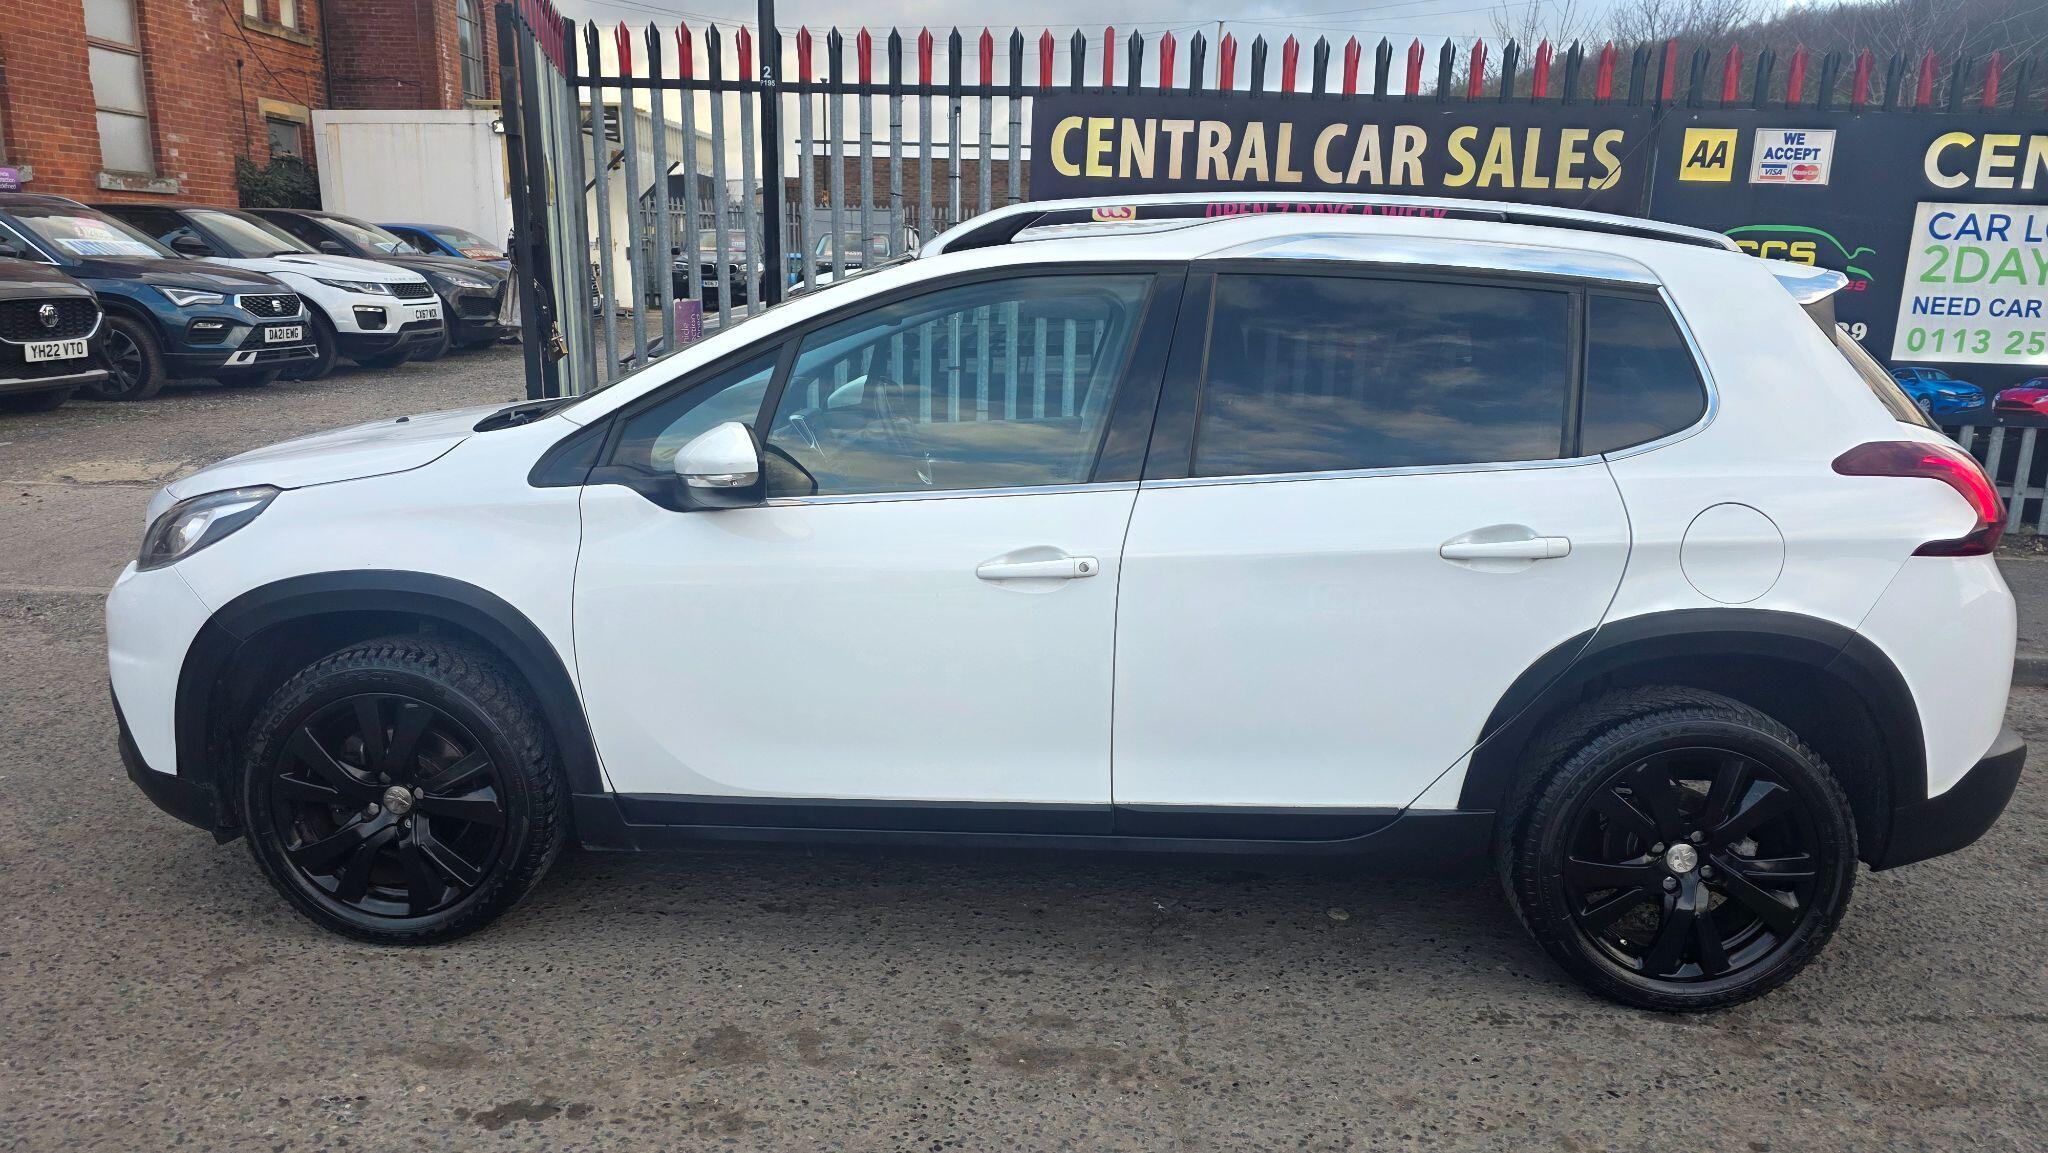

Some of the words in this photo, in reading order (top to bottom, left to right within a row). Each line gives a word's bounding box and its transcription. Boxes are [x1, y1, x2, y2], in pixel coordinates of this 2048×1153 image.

[763, 65, 771, 78] 2
[1784, 132, 1806, 146] WE
[1050, 116, 1303, 183] CENTRAL
[1313, 123, 1428, 186] CAR
[1443, 126, 1625, 191] SALES
[1686, 140, 1729, 169] AA
[1763, 147, 1821, 161] ACCEPT
[1765, 168, 1783, 176] VISA
[1928, 211, 2012, 242] CAR
[2024, 214, 2048, 243] L
[1912, 296, 1981, 316] NEED
[1988, 298, 2043, 318] CAR
[269, 327, 285, 340] DA21
[1907, 327, 1991, 354] 0113
[2004, 330, 2047, 356] 25
[31, 343, 60, 358] YH22
[63, 341, 84, 355] VTO
